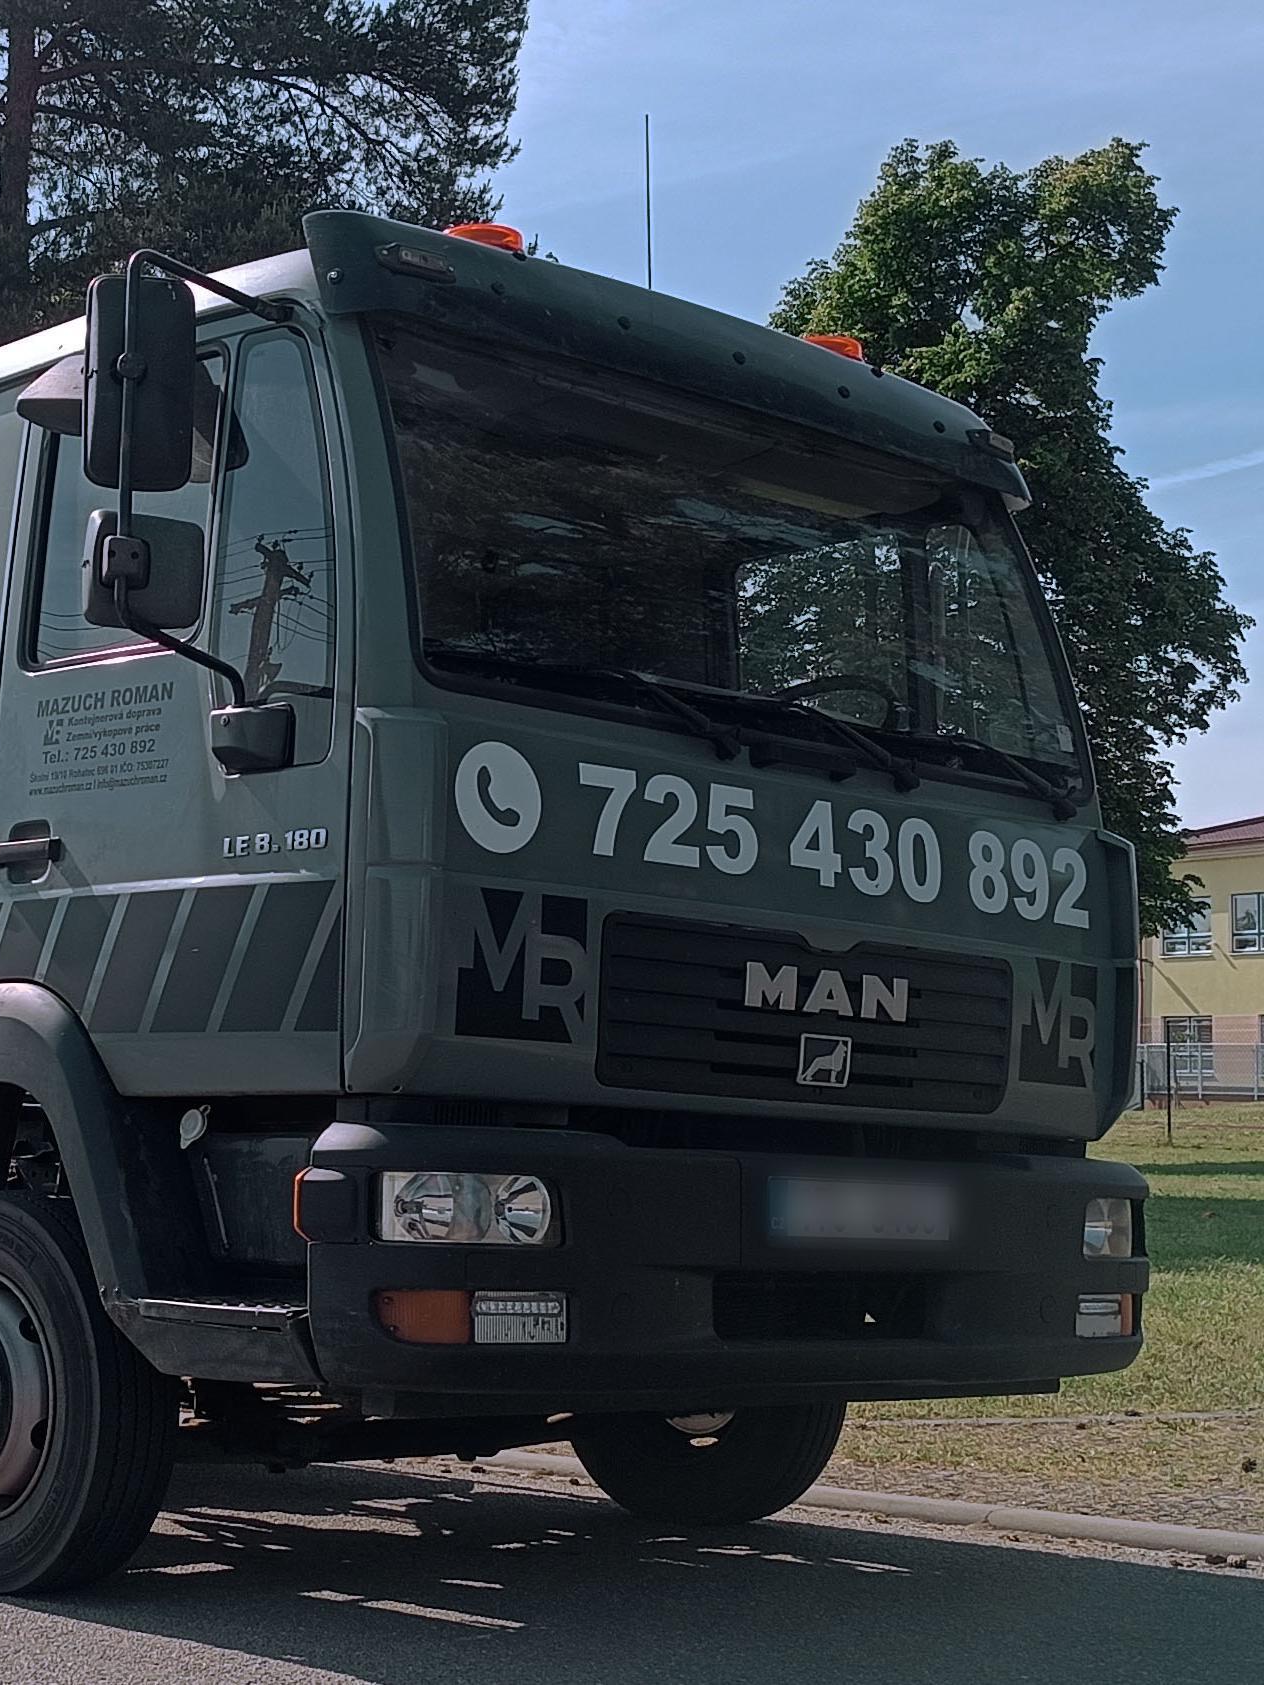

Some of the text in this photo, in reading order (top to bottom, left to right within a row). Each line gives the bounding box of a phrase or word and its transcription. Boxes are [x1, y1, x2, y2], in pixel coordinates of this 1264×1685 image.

[37, 681, 174, 718] MAZUCH ROMAN
[126, 707, 162, 720] doprava
[43, 739, 156, 764] Tel.: 725 430 892
[579, 761, 1091, 929] 725 430 892
[455, 887, 589, 1044] MR
[744, 961, 909, 1023] MAN
[1017, 957, 1096, 1088] MR
